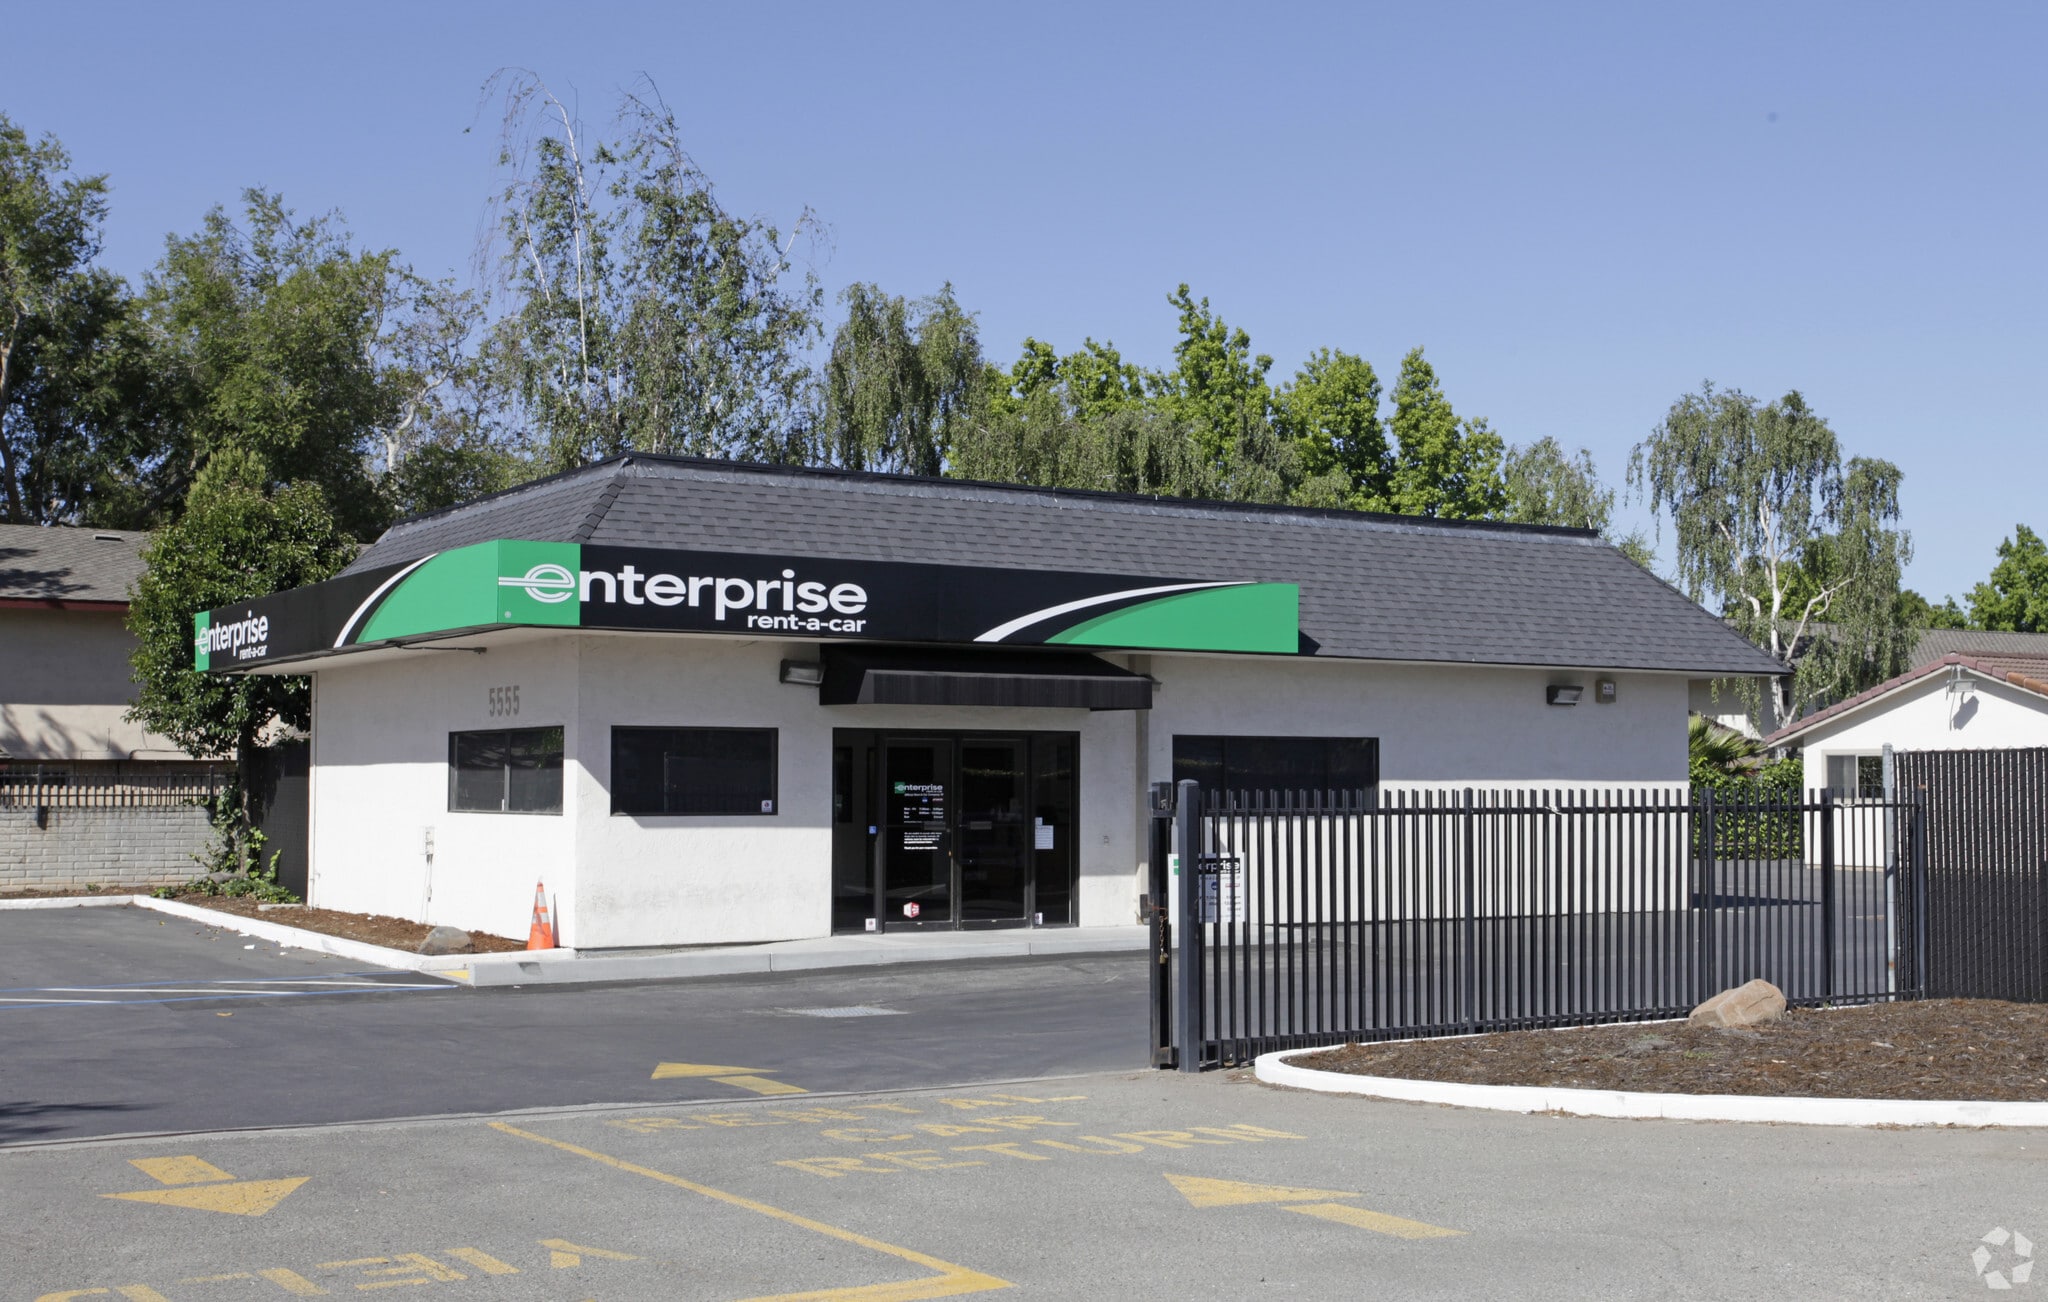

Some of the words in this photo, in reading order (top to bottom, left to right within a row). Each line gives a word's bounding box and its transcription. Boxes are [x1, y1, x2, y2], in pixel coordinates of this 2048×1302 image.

[499, 563, 868, 621] enterprise
[195, 610, 268, 657] enterprise
[748, 613, 867, 633] rent-a-car
[239, 645, 268, 661] rent-a-car
[489, 685, 520, 717] 5555
[895, 784, 943, 793] enterprise
[605, 1094, 1088, 1133] RENTAL
[820, 1115, 1080, 1142] CAR
[775, 1124, 1308, 1177] RETURN
